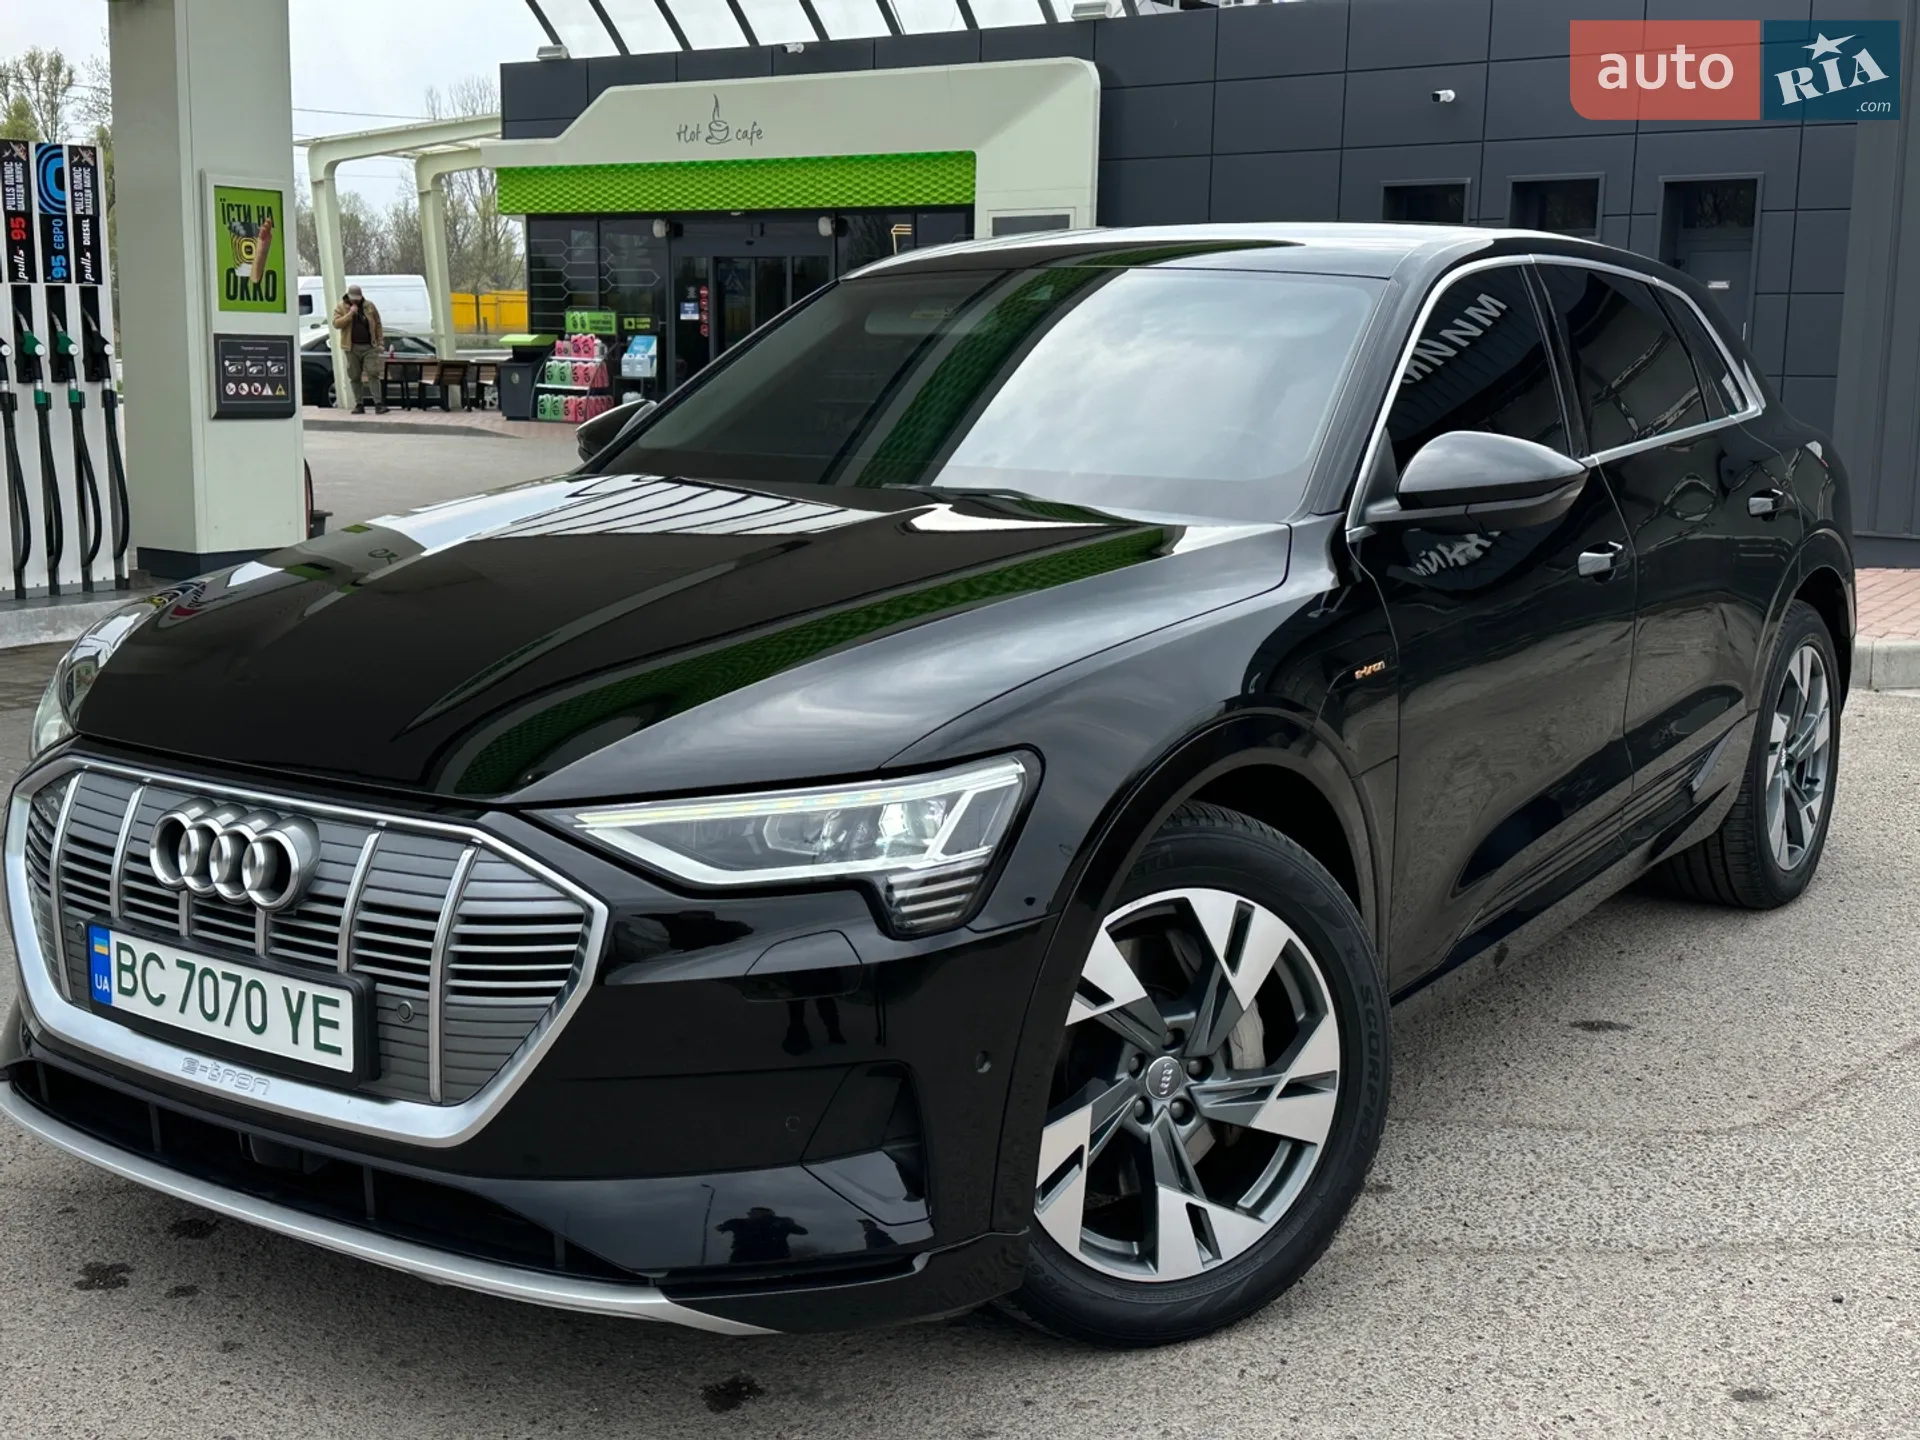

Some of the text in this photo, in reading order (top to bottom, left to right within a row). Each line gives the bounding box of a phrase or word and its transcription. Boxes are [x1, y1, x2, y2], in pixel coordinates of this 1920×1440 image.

[676, 121, 763, 146] Hot cafe
[220, 198, 275, 228] ЇСТИ НА
[10, 217, 27, 241] 95
[81, 218, 91, 246] DIESEL
[51, 218, 67, 279] 95 ЄВРО
[226, 267, 277, 302] ОККО
[94, 941, 343, 1056] UA BC 7070 YE
